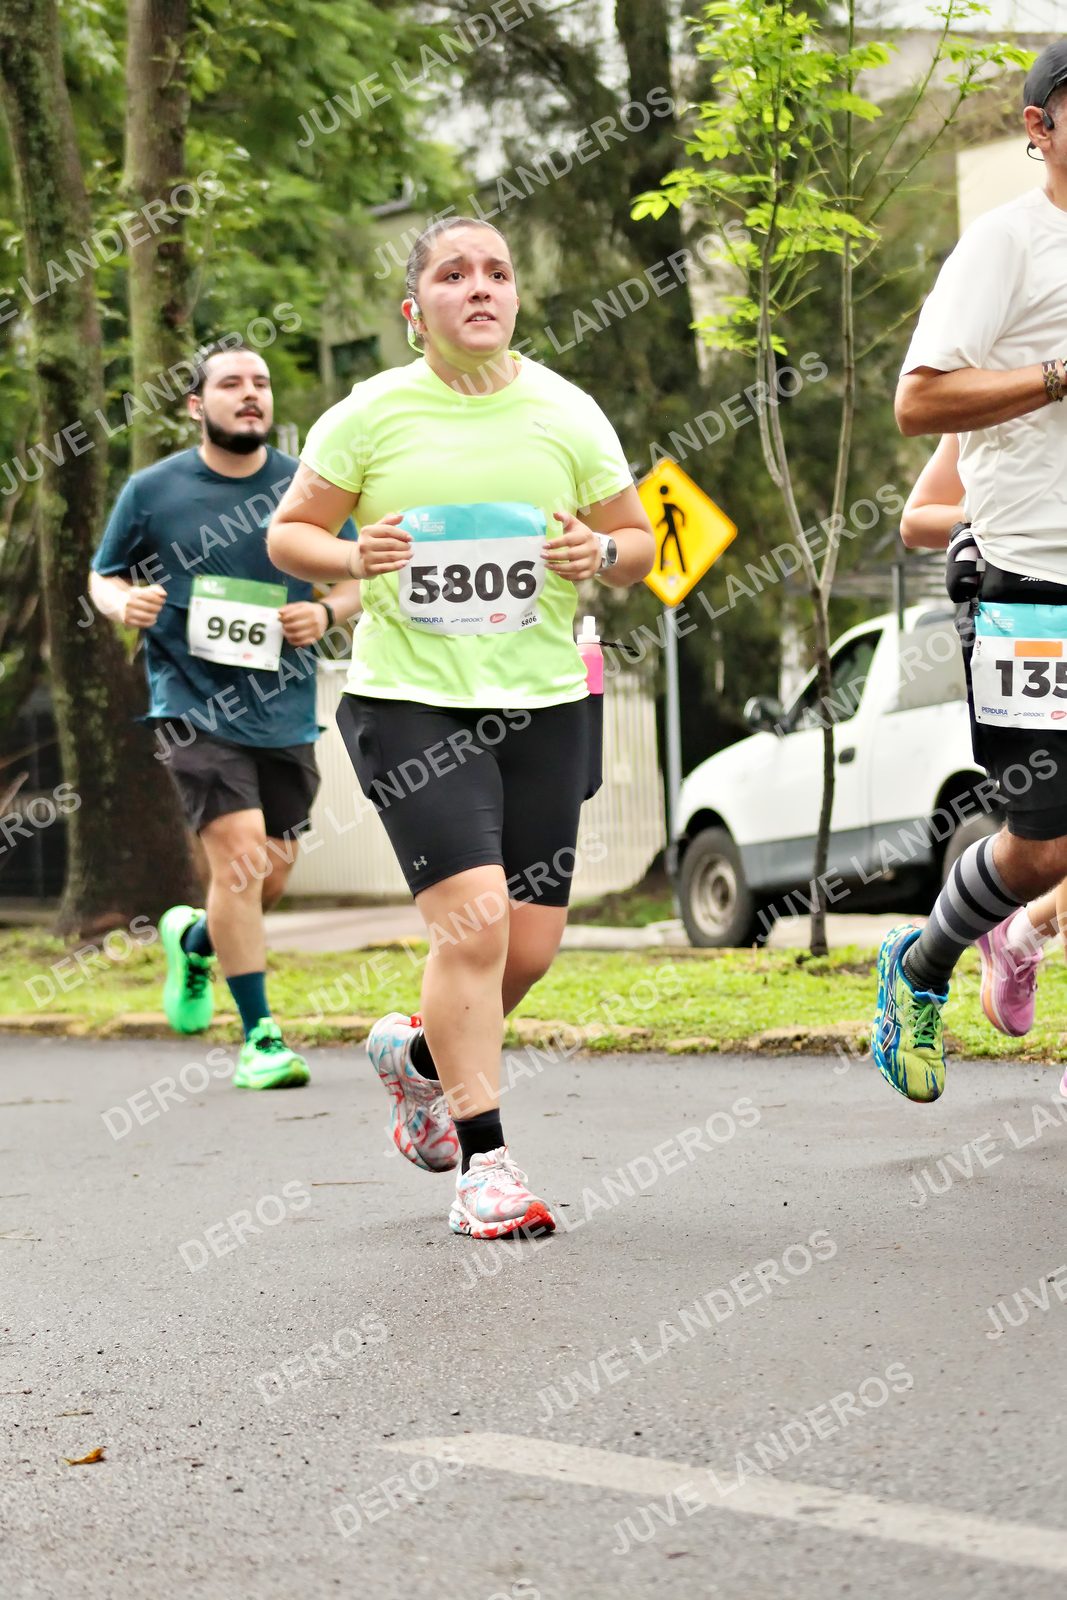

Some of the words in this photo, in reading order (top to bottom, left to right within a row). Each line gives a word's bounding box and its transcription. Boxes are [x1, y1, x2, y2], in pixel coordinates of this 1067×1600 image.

[409, 560, 537, 605] 5806
[411, 616, 444, 624] PERDURA
[521, 616, 537, 627] 5806
[207, 616, 267, 646] 966
[981, 706, 1008, 716] PERDURA
